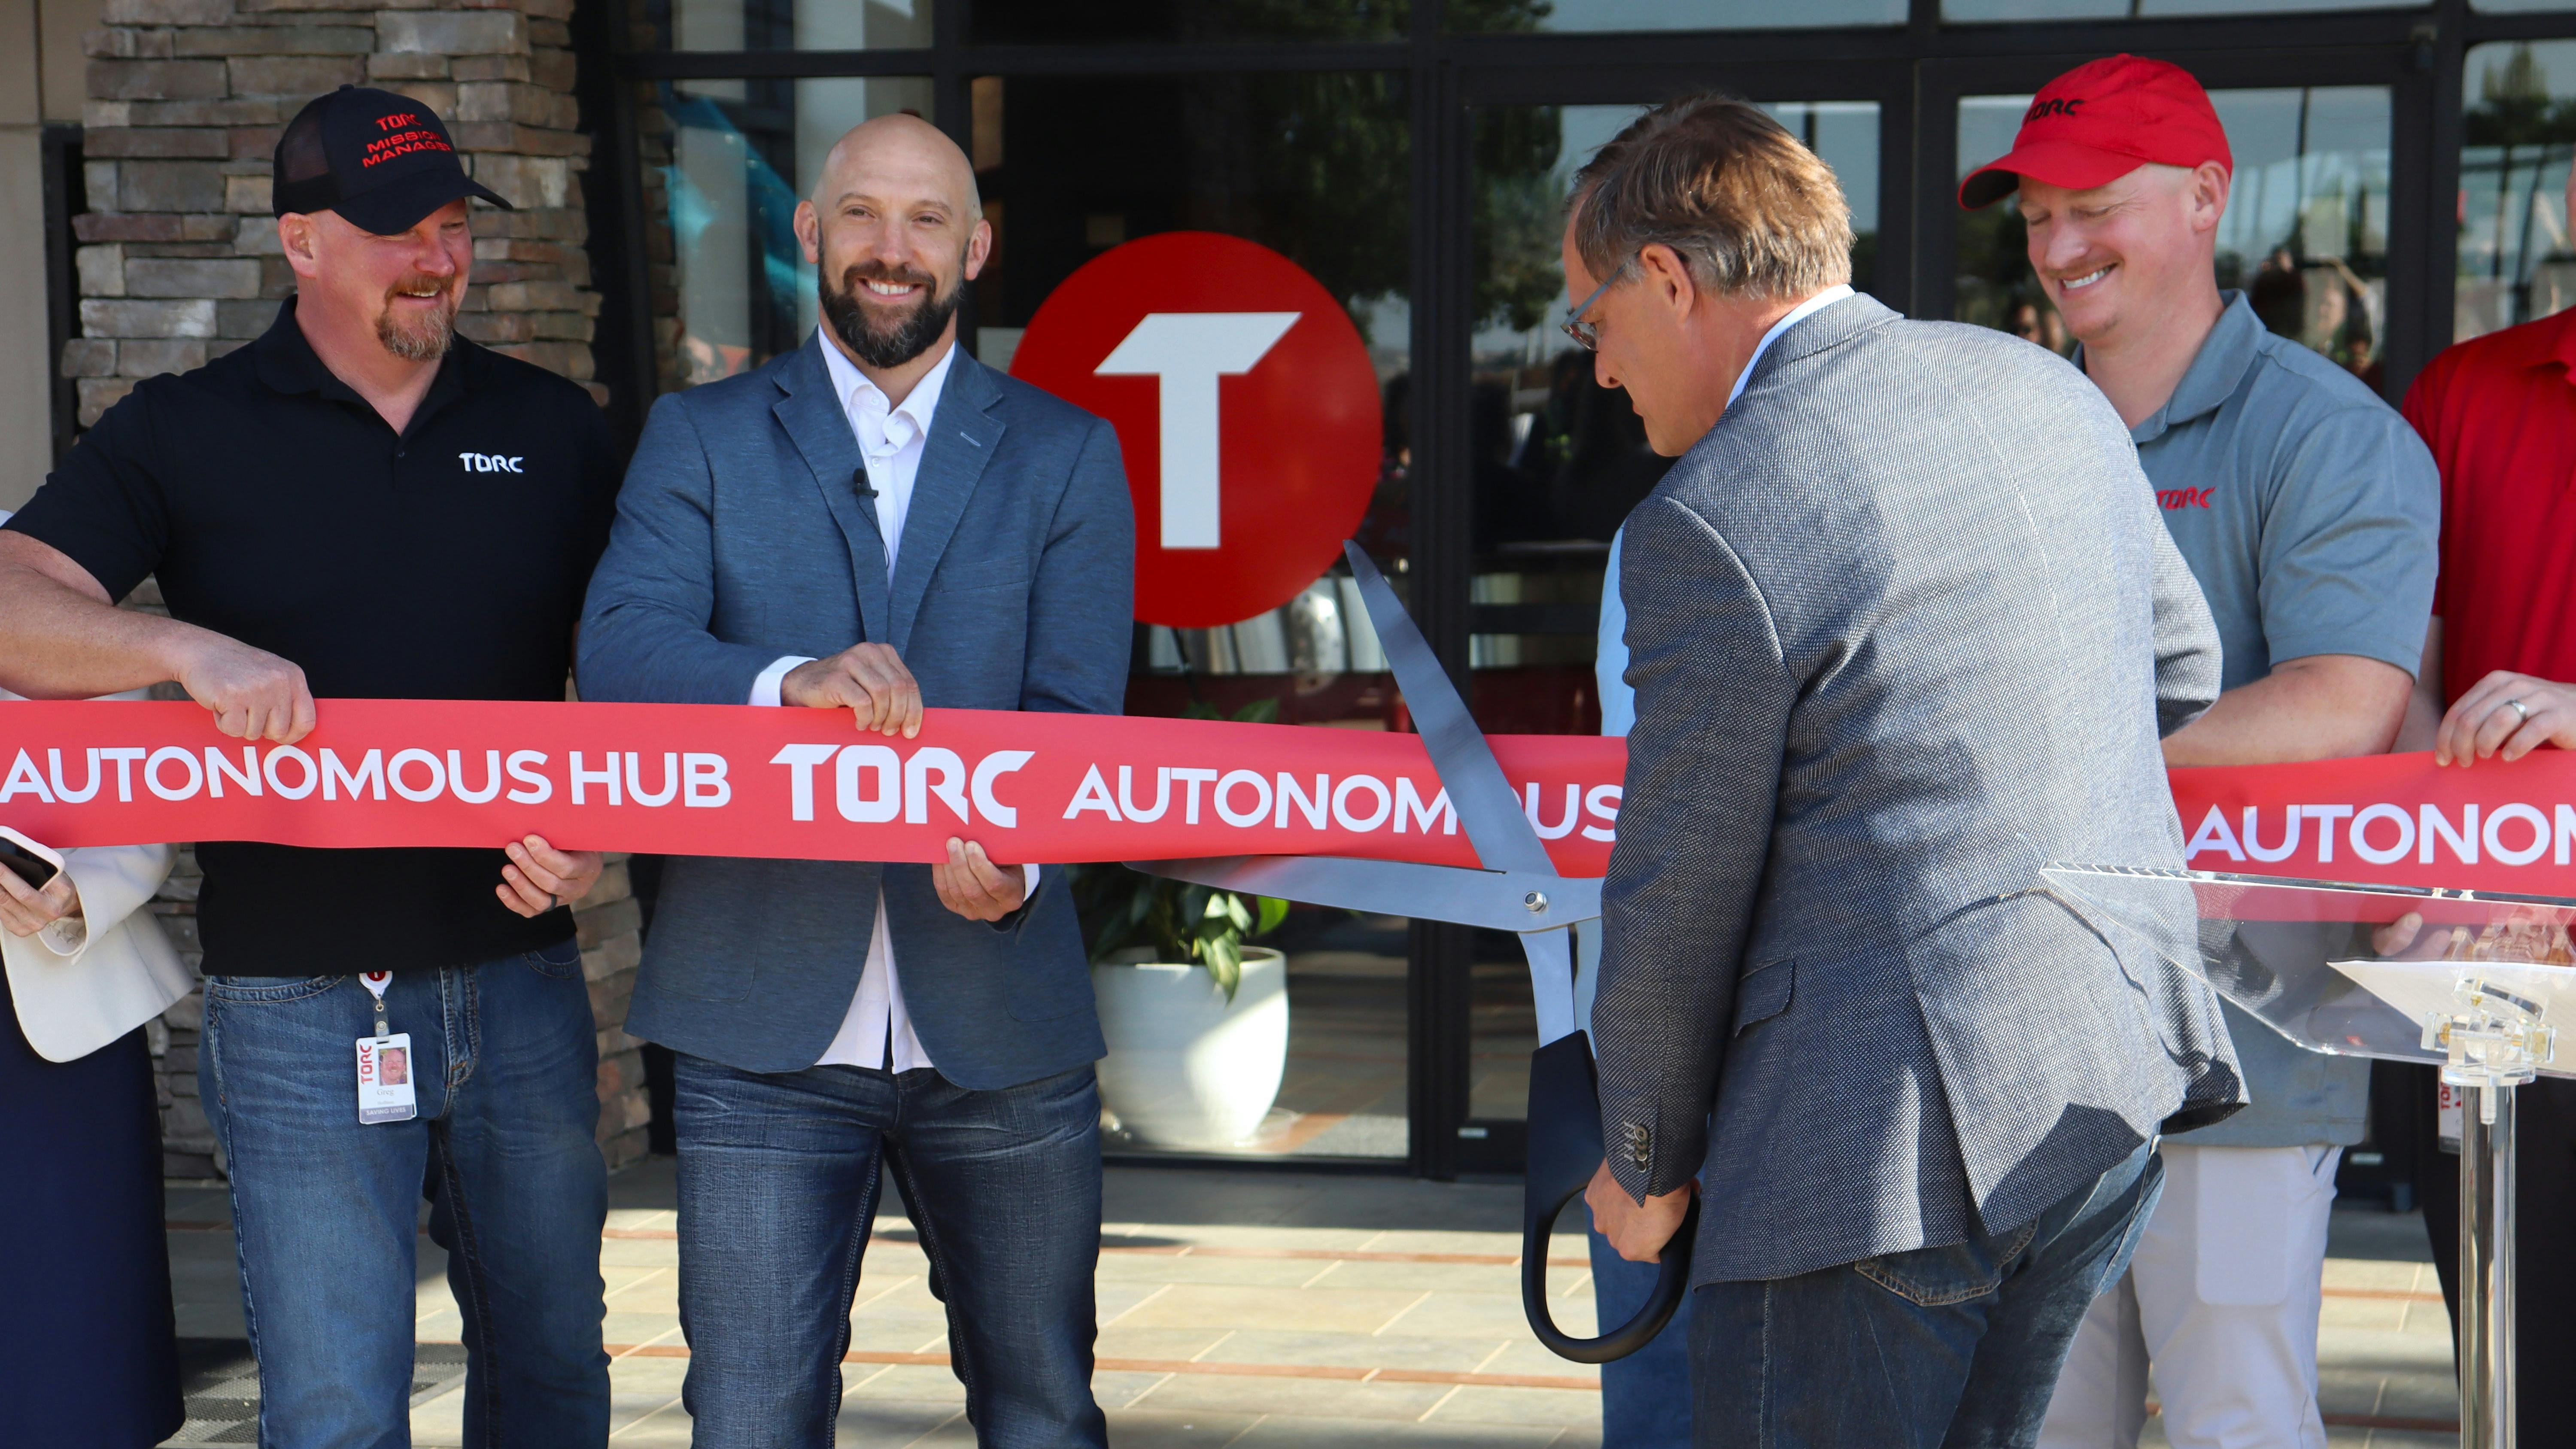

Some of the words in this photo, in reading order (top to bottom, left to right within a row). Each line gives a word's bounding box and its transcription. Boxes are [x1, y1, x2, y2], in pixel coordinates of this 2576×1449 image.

[375, 113, 422, 131] TORC
[362, 141, 452, 168] MANAGER
[367, 131, 440, 153] MISSION
[1093, 312, 1303, 549] T
[458, 453, 523, 473] TORC
[2155, 486, 2216, 510] TORC
[0, 744, 553, 805] AUTONOMOUS
[569, 750, 731, 808] HUB
[769, 743, 1036, 828] TORC
[1062, 762, 1623, 842] AUTONOMUS
[359, 1044, 373, 1085] TORC
